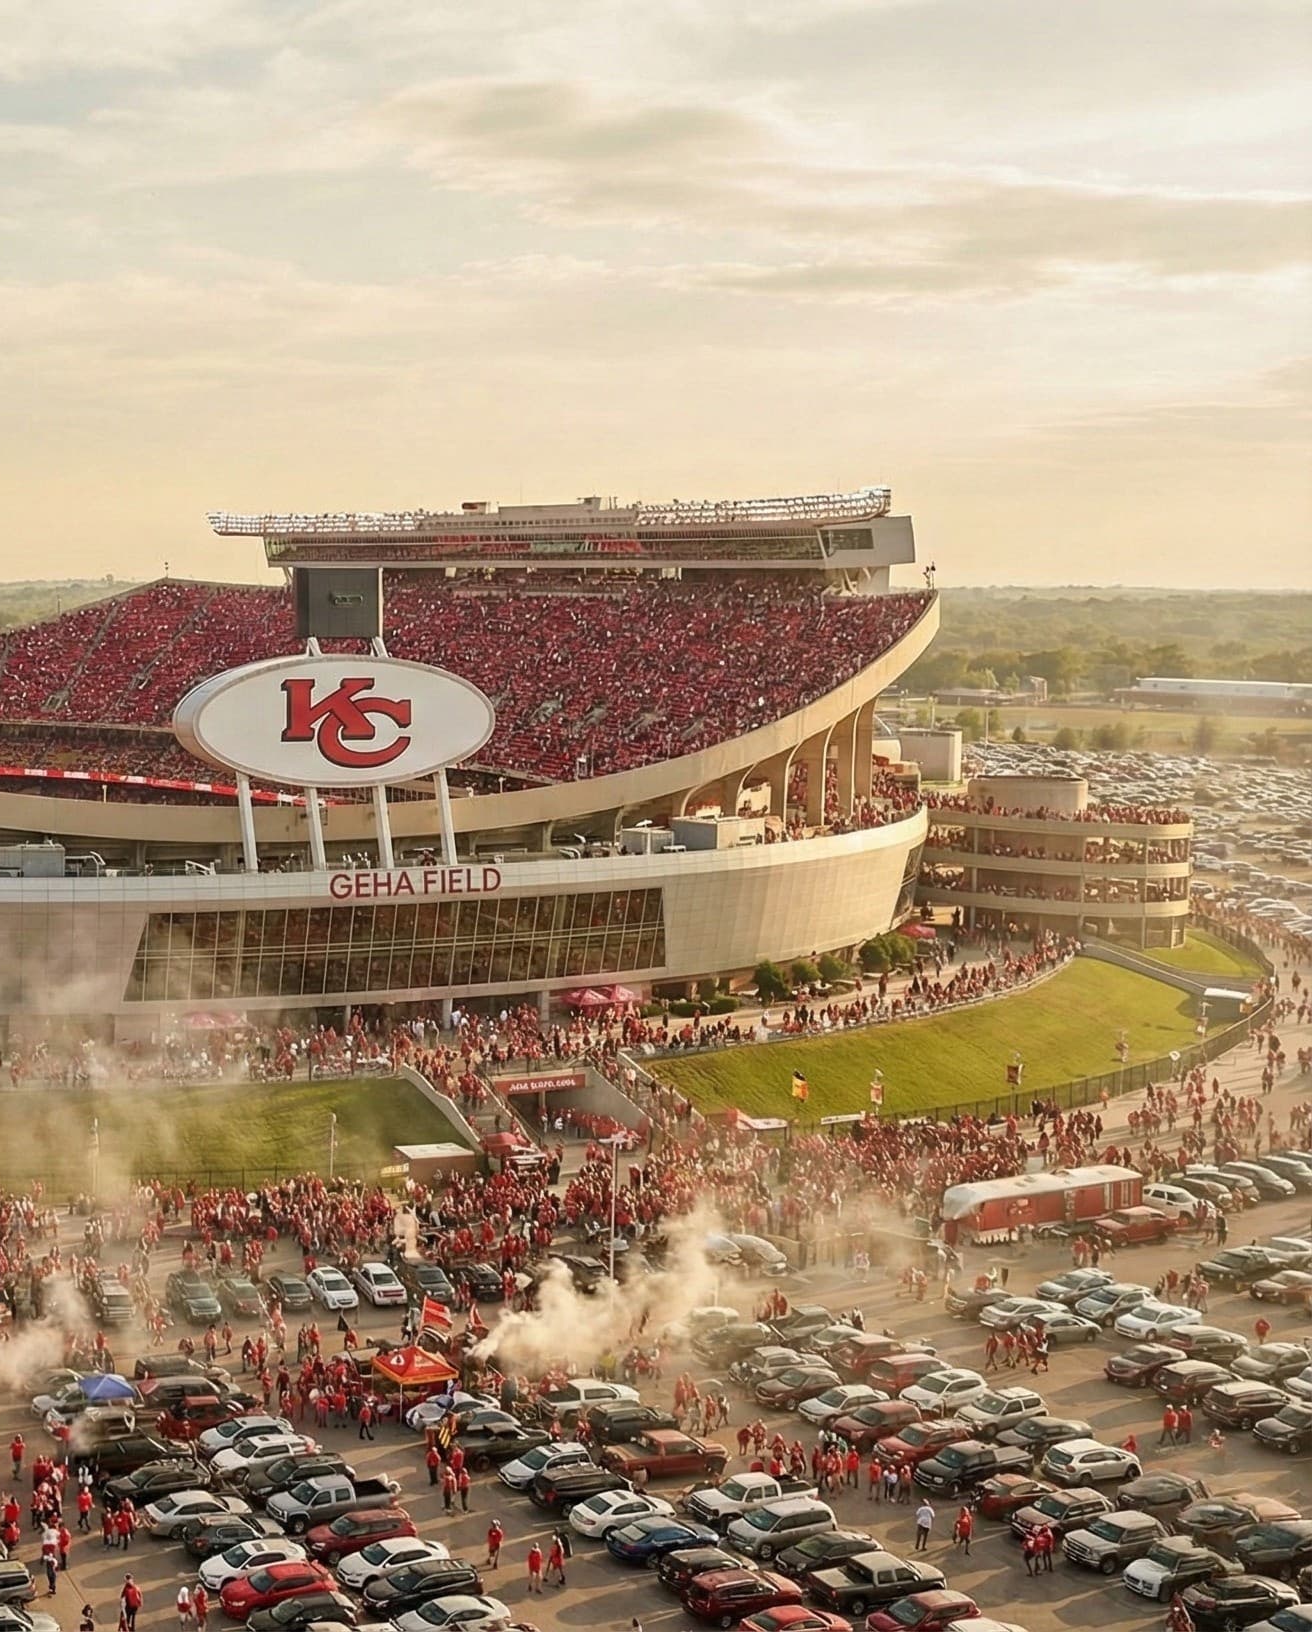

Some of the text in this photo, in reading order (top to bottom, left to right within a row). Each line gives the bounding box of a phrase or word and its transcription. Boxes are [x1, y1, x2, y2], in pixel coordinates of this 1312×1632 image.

[280, 677, 412, 769] KC
[329, 867, 502, 900] GEHA FIELD
